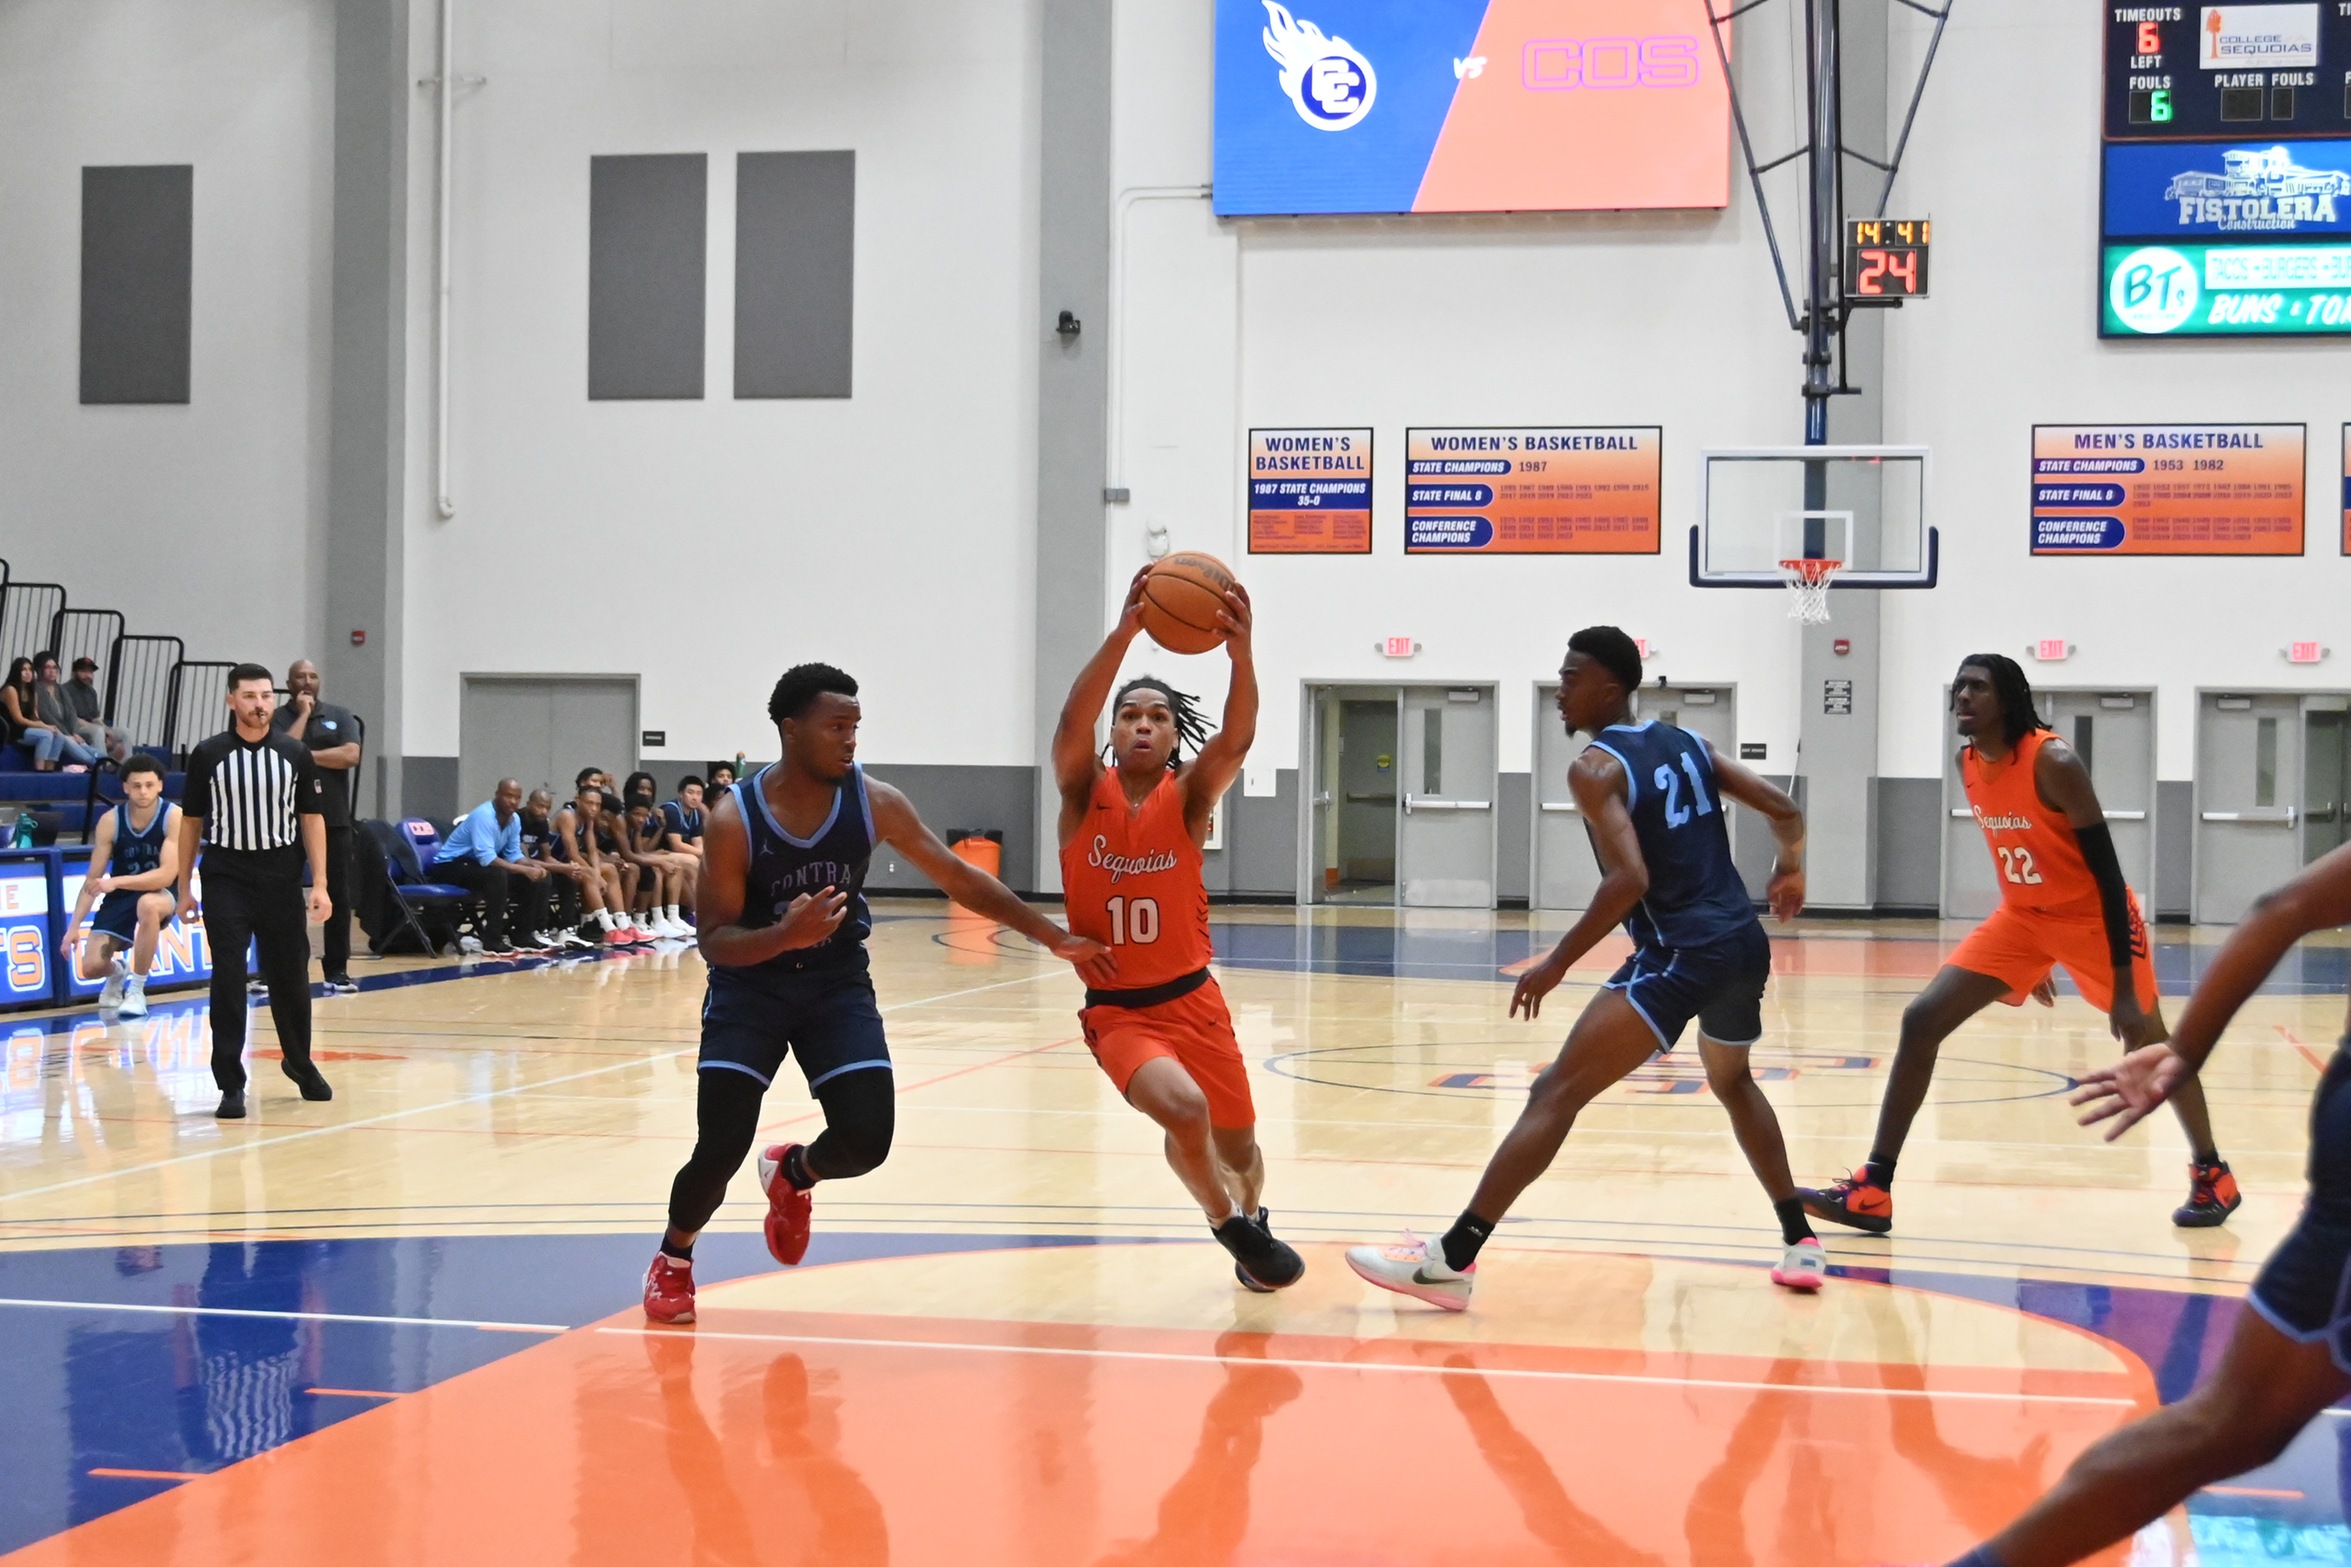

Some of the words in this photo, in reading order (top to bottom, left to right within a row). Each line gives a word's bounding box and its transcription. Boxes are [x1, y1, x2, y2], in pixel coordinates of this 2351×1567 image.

[2115, 8, 2181, 22] TIMEOUTS
[2138, 21, 2160, 54] 6
[2219, 34, 2282, 44] COLLEGE
[2220, 43, 2312, 55] SEQUOIAS
[1523, 36, 1698, 90] COS
[2130, 55, 2162, 69] LEFT
[2129, 76, 2171, 89] FOULS
[2214, 73, 2264, 88] PLAYER
[2271, 72, 2314, 86] FOULS
[2150, 90, 2173, 122] 6
[2178, 194, 2337, 225] FISTOLERA
[2217, 213, 2296, 231] Construction
[1859, 250, 1916, 294] 24
[2262, 256, 2317, 279] BURGERS
[2208, 294, 2283, 325] BUNS
[1265, 437, 1350, 451] WOMEN'S
[1431, 436, 1518, 451] WOMEN'S
[1525, 436, 1638, 450] BASKETBALL
[2074, 433, 2135, 449] MEN'S
[2142, 433, 2264, 449] BASKETBALL
[1256, 456, 1364, 470] BASKETBALL
[1412, 462, 1442, 473] STATE
[1444, 461, 1505, 473] CHAMPIONS
[1519, 461, 1547, 473] 1987
[2038, 460, 2070, 472] STATE
[2072, 460, 2138, 472] CHAMPIONS
[2153, 460, 2184, 471] 1953
[2193, 460, 2225, 471] 1982
[1279, 484, 1307, 494] STATE
[1309, 483, 1366, 494] CHAMPIONS
[1412, 491, 1442, 501] STATE
[1443, 490, 1472, 501] FINAL
[1474, 490, 1482, 501] 8
[2038, 490, 2070, 501] STATE
[2072, 489, 2103, 501] FINAL
[2105, 489, 2113, 501] 8
[1297, 495, 1321, 506] 35-0
[1411, 521, 1477, 532] CONFERENCE
[2038, 521, 2107, 532] CONFERENCE
[1411, 532, 1471, 544] CHAMPIONS
[2037, 533, 2101, 544] CHAMPIONS
[1388, 637, 1411, 655] EXIT
[2040, 639, 2064, 658] EXIT
[2292, 642, 2317, 661] EXIT
[1654, 751, 1712, 829] 21
[1973, 805, 2032, 837] Sequoias
[1088, 834, 1178, 884] Sequoias
[1997, 846, 2043, 885] 22
[1106, 895, 1160, 945] 10
